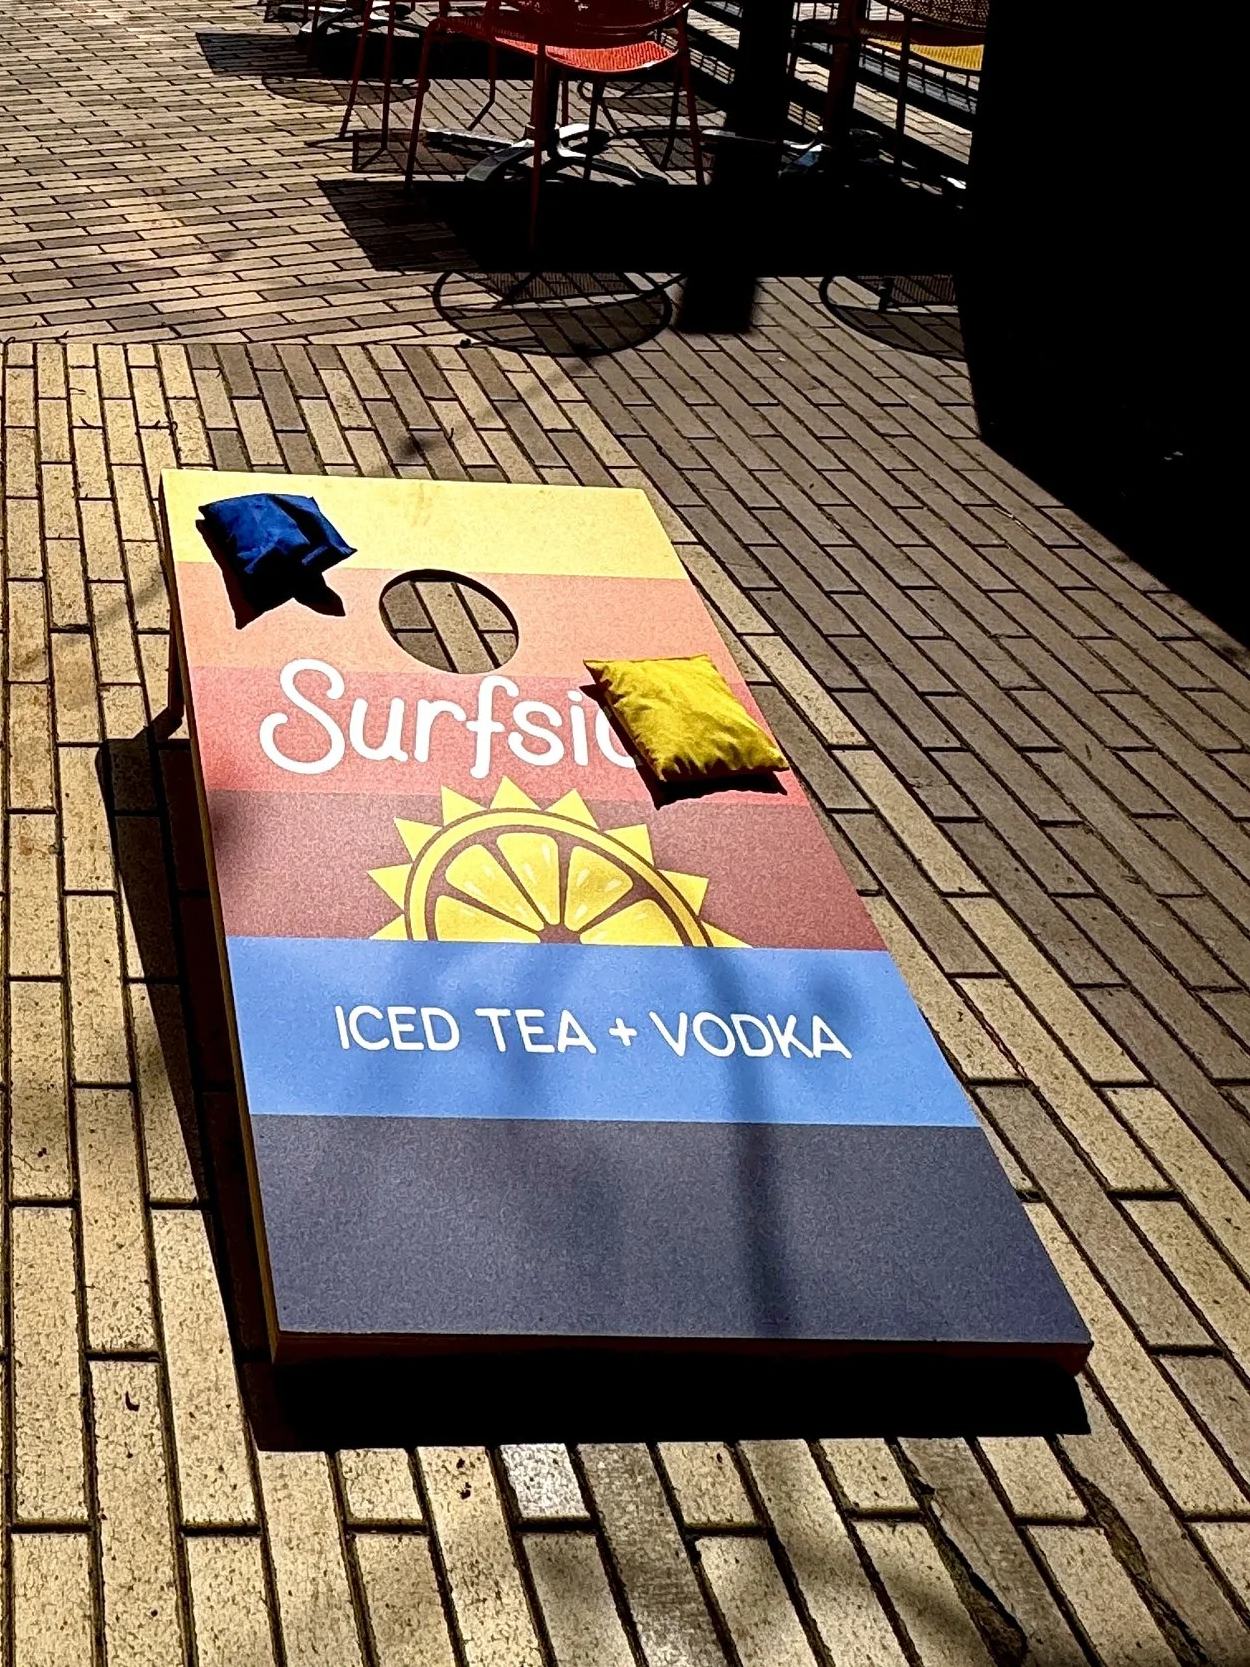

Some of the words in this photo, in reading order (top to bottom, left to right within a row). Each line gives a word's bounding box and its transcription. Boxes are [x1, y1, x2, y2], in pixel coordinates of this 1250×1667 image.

[258, 657, 637, 780] Surfsi
[334, 1004, 461, 1052] ICED
[473, 1007, 598, 1055] TEA
[607, 1017, 639, 1047] +
[647, 1010, 853, 1060] VODKA
